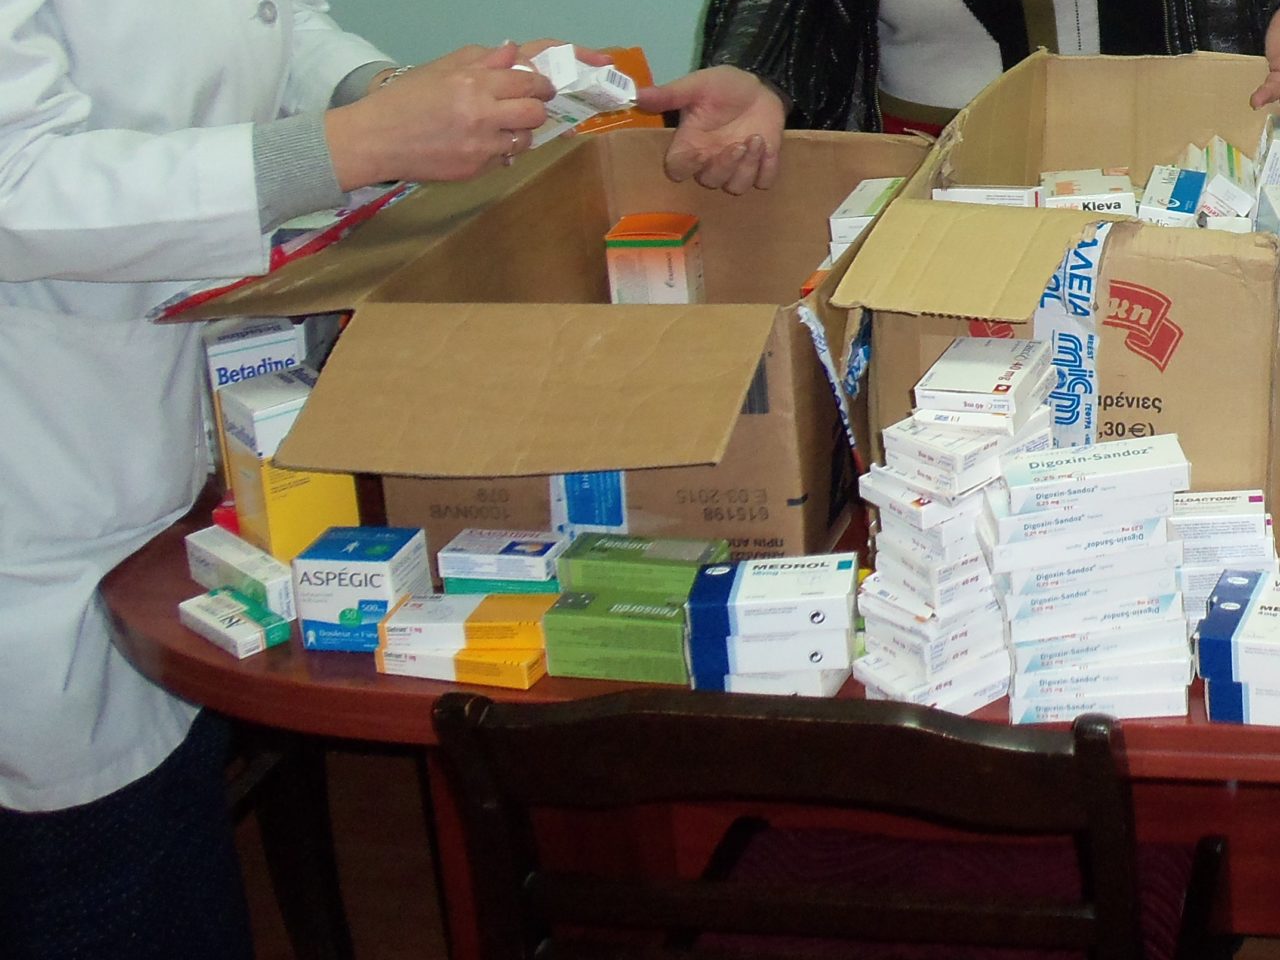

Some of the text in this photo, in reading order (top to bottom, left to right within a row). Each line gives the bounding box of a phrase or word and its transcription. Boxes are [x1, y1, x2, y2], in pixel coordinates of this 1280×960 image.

[1082, 200, 1122, 212] Kleva
[216, 356, 296, 386] Betadine
[1097, 392, 1163, 414] ρένιες
[1029, 447, 1151, 471] Digoxin-Sandoz
[1036, 486, 1096, 501] Digoxin-Sandoz
[1024, 515, 1083, 531] Digoxin-Sandoz
[752, 561, 830, 571] MEDROL
[1036, 564, 1094, 581] Digoxin-Sandoz
[299, 566, 383, 589] ASPÉGIC
[1031, 590, 1089, 606] Digoxin-Sandoz
